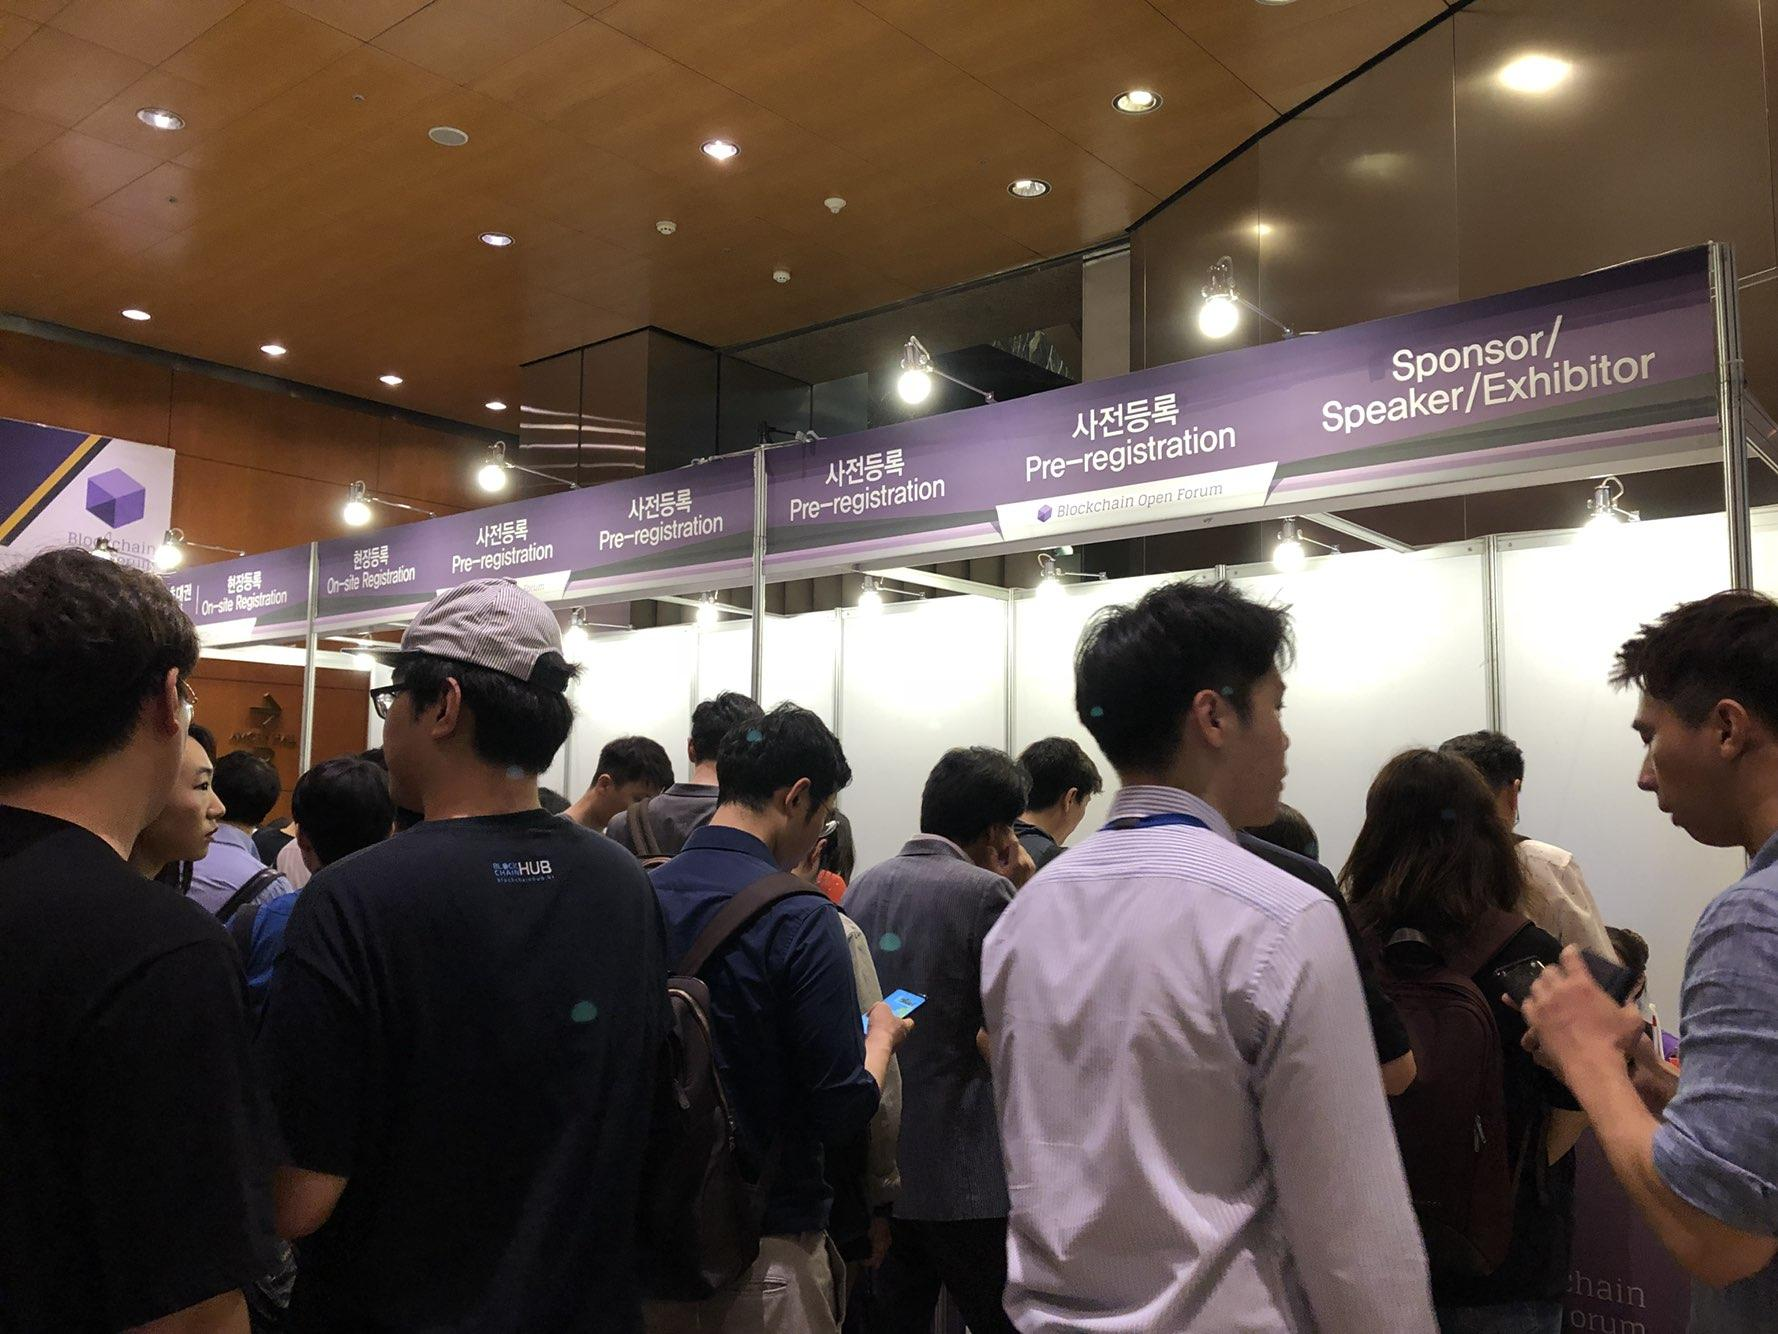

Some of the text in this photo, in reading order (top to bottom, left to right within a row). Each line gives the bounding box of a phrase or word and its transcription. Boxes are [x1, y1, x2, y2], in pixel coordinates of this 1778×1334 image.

[1392, 315, 1563, 383] Sponsor/
[1322, 352, 1656, 434] Speaker/Exhibitor
[1072, 392, 1180, 441] 사전등록
[825, 448, 905, 488] 사전등록
[1025, 426, 1237, 482] Pre-registration
[628, 488, 692, 521] 사전등록
[790, 476, 946, 522] Pre-registration
[1057, 484, 1223, 518] Blockchain Open Forum
[68, 531, 156, 556] Blochain
[476, 518, 529, 548] 사전등록
[599, 513, 723, 551] Pre-registration
[353, 545, 390, 570] 현장등록
[452, 542, 554, 574] Pre-registration
[227, 570, 262, 594] 현장등록
[327, 565, 416, 595] On-site Registration
[201, 588, 288, 616] On-site Registration
[518, 860, 553, 876] HUB
[1570, 1309, 1646, 1334] orum
